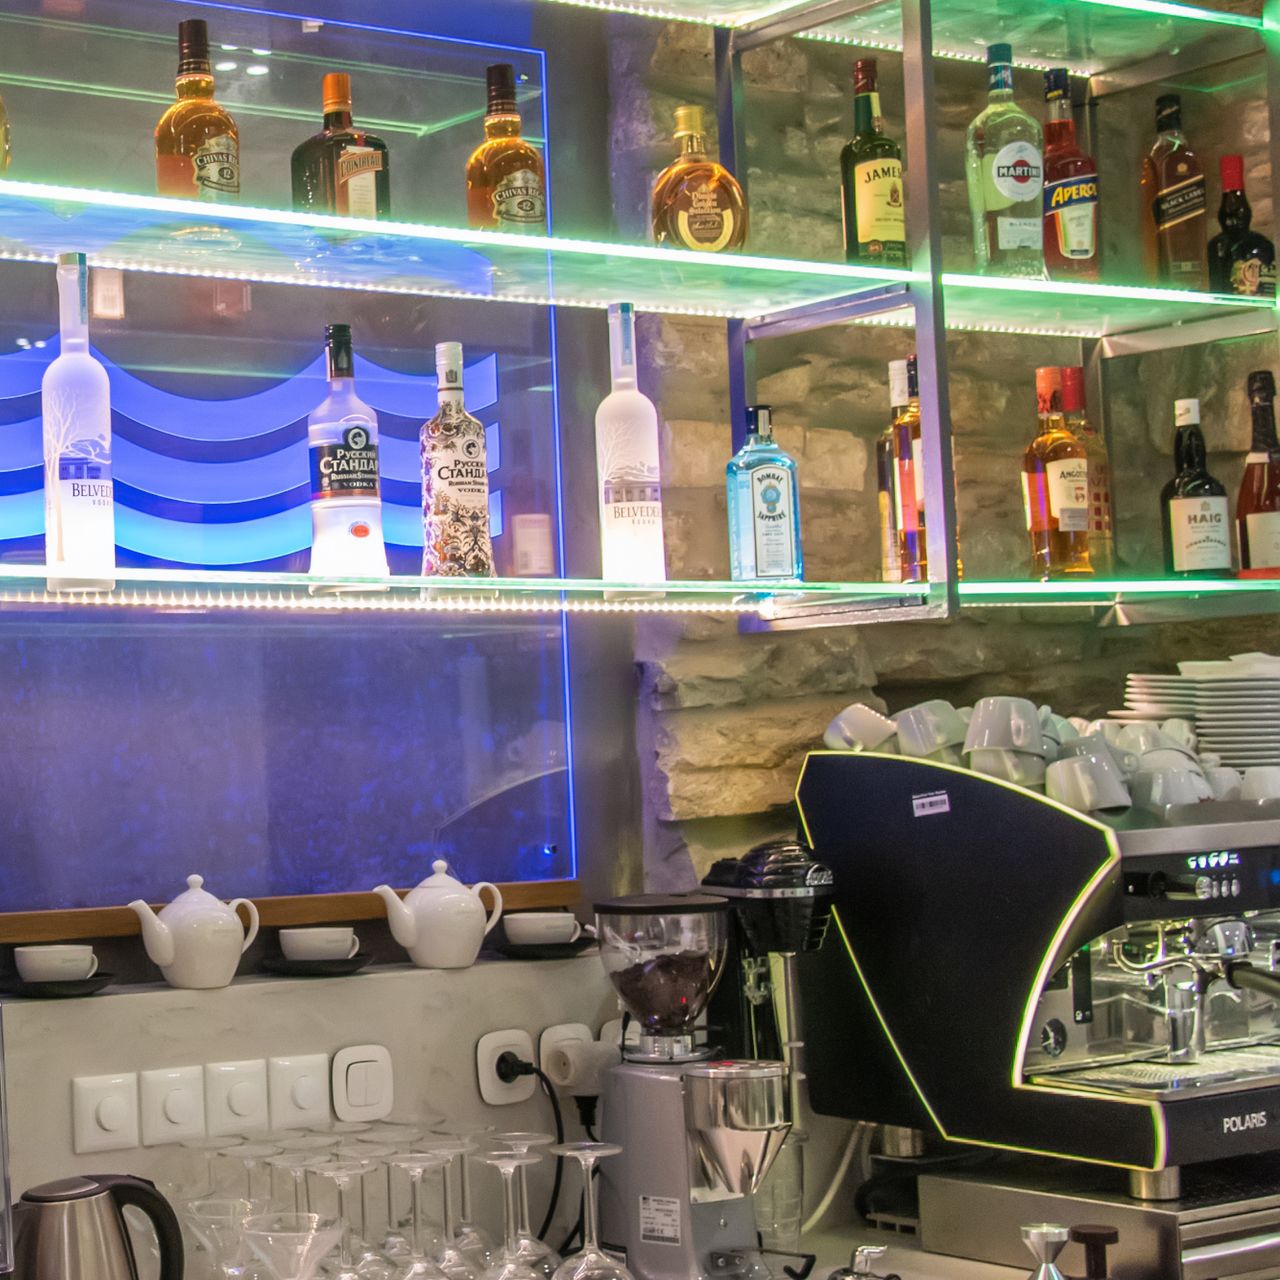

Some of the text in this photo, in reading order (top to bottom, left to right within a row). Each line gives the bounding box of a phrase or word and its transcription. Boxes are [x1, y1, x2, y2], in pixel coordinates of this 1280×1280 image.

[196, 153, 228, 166] CHIVAS
[495, 187, 527, 201] CHIVAS
[757, 472, 784, 484] BOMBAY
[757, 510, 787, 523] SAPPHIRE
[1187, 513, 1223, 525] HAIG
[1222, 1111, 1268, 1134] POLARIS
